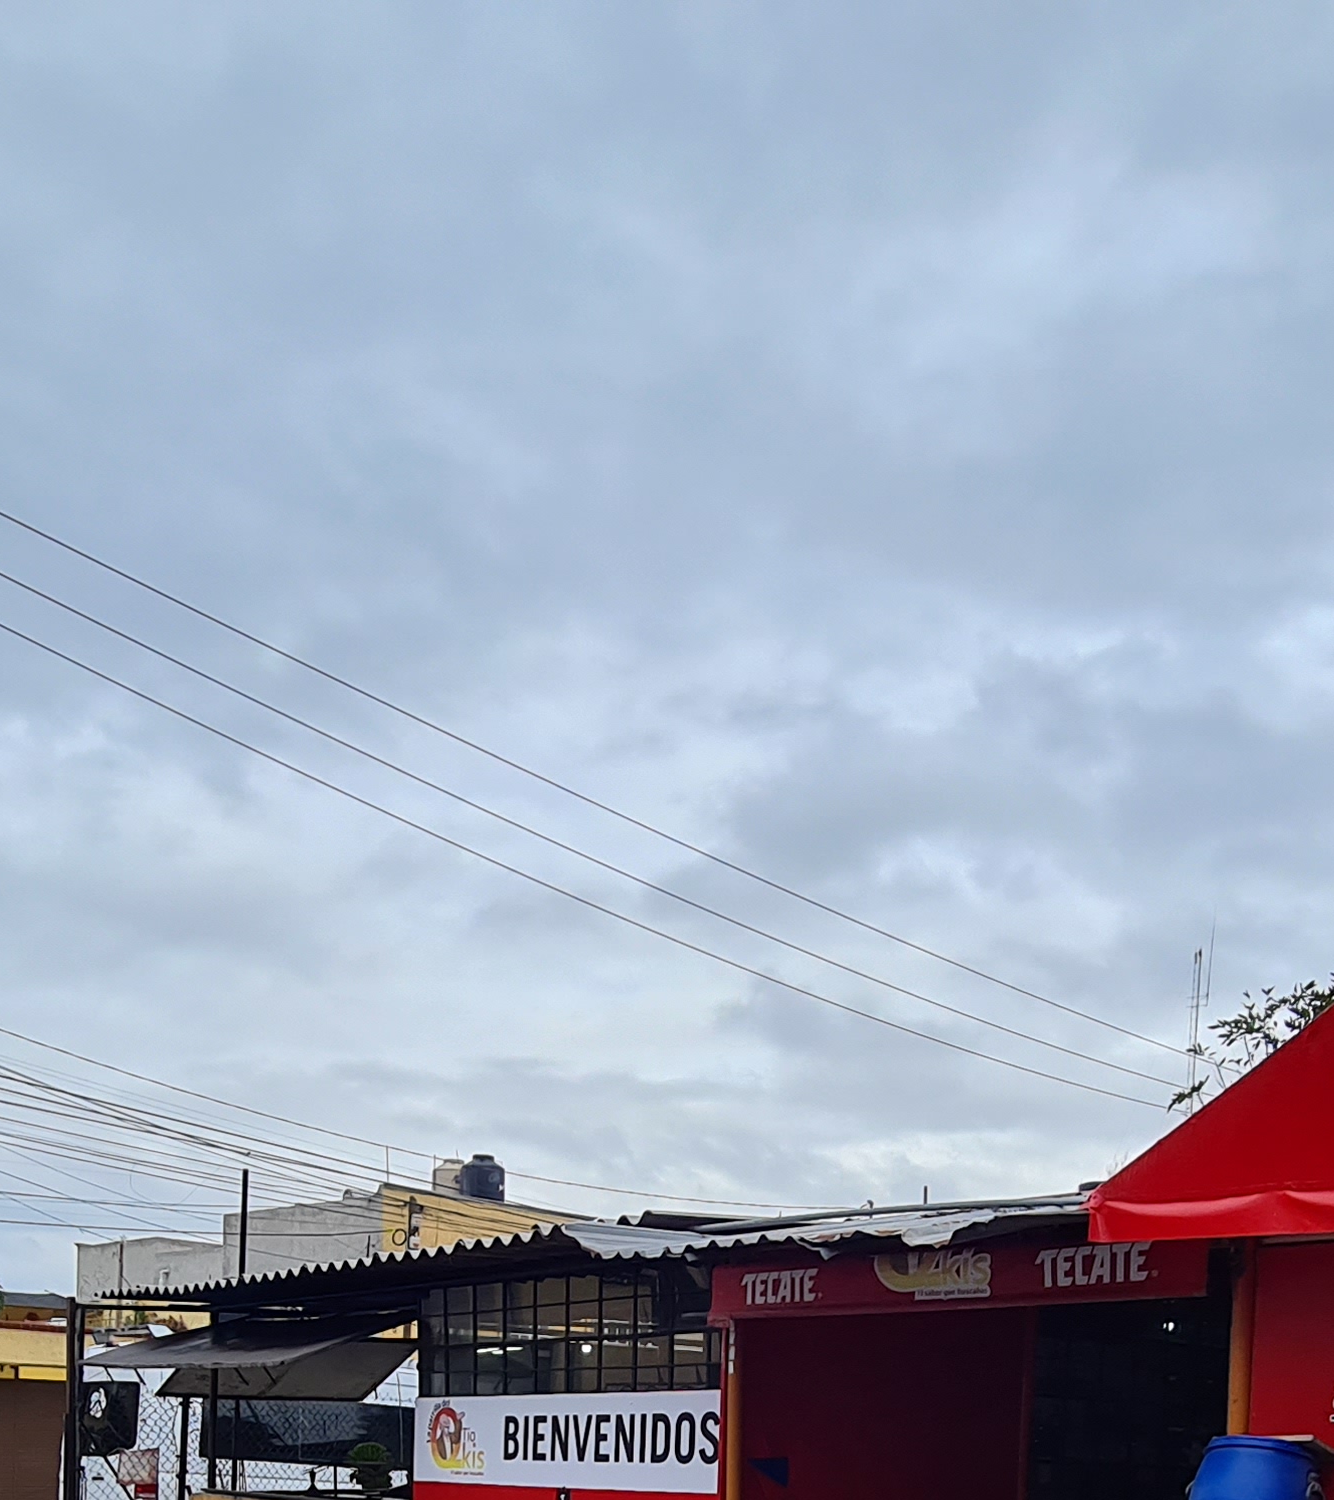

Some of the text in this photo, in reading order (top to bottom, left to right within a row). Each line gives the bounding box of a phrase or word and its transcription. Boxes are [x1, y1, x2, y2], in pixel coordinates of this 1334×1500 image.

[740, 1267, 819, 1306] TECATE
[1034, 1241, 1152, 1288] TECATE
[503, 1411, 720, 1465] BIENVENIDOS
